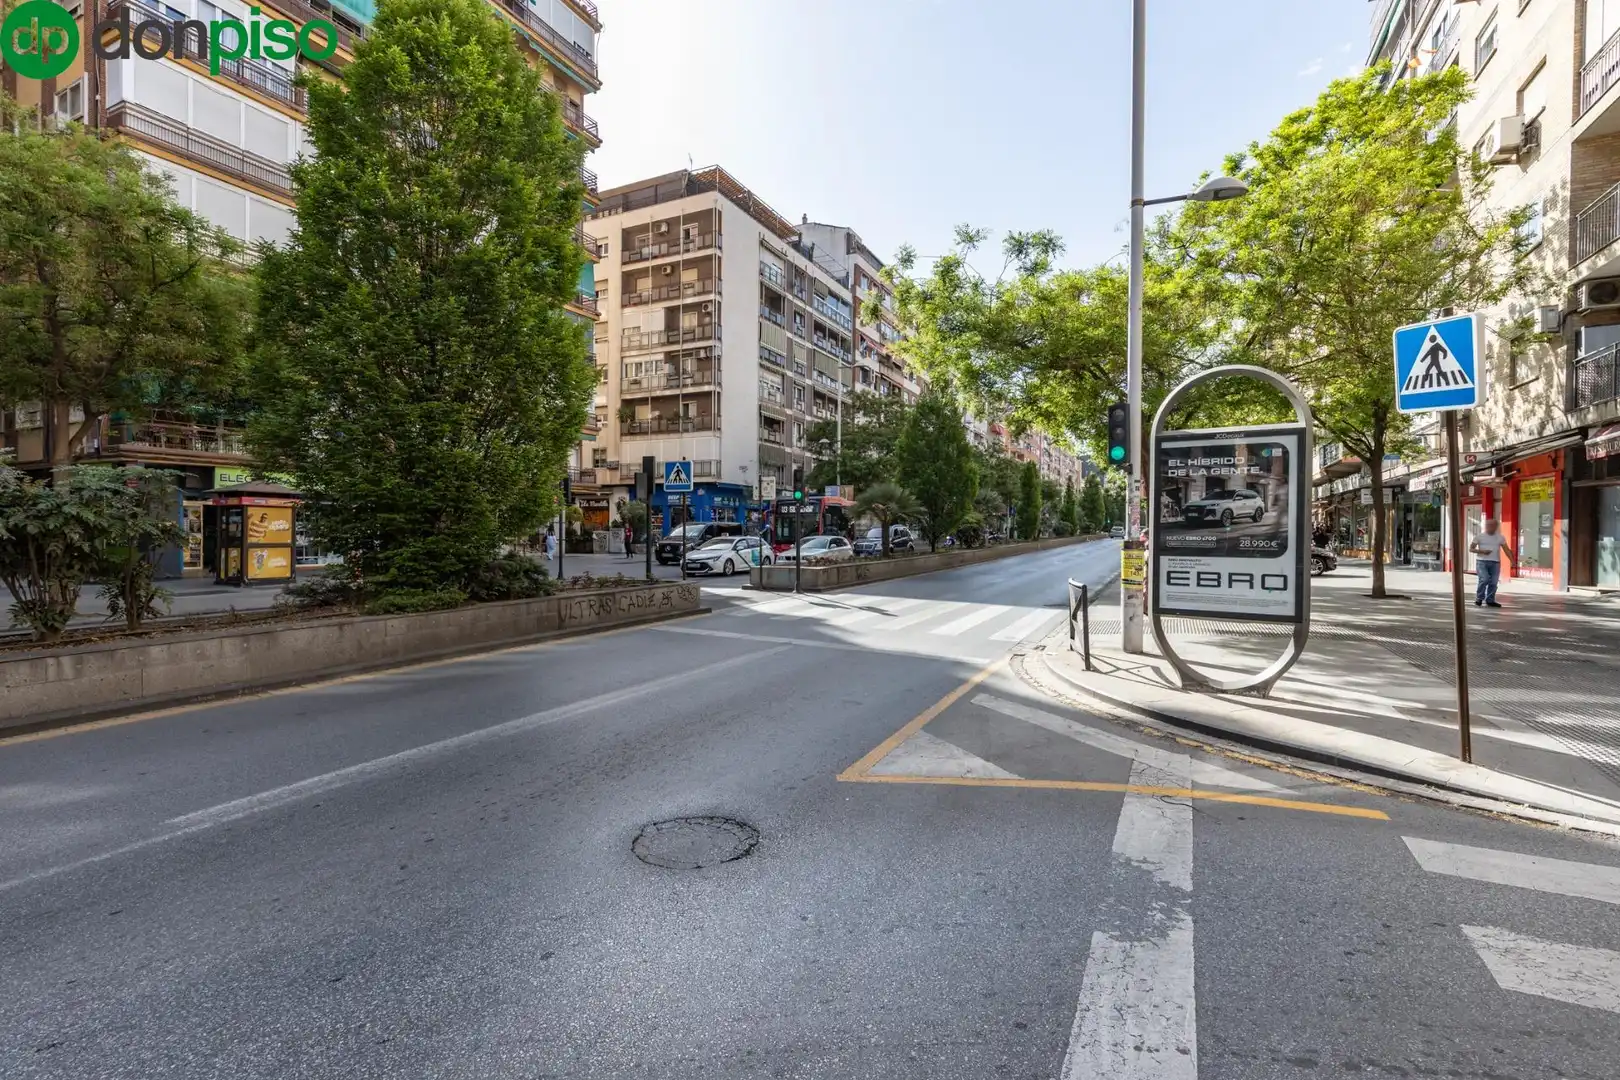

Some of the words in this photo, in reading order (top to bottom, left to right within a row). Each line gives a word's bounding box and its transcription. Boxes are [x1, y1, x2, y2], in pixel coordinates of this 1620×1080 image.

[1168, 459, 1185, 467] EL
[1187, 456, 1245, 466] HÍBRIDO
[1168, 469, 1187, 477] DE
[1189, 468, 1208, 476] LA
[1210, 466, 1263, 476] GENTE.
[1166, 571, 1288, 591] EBRO
